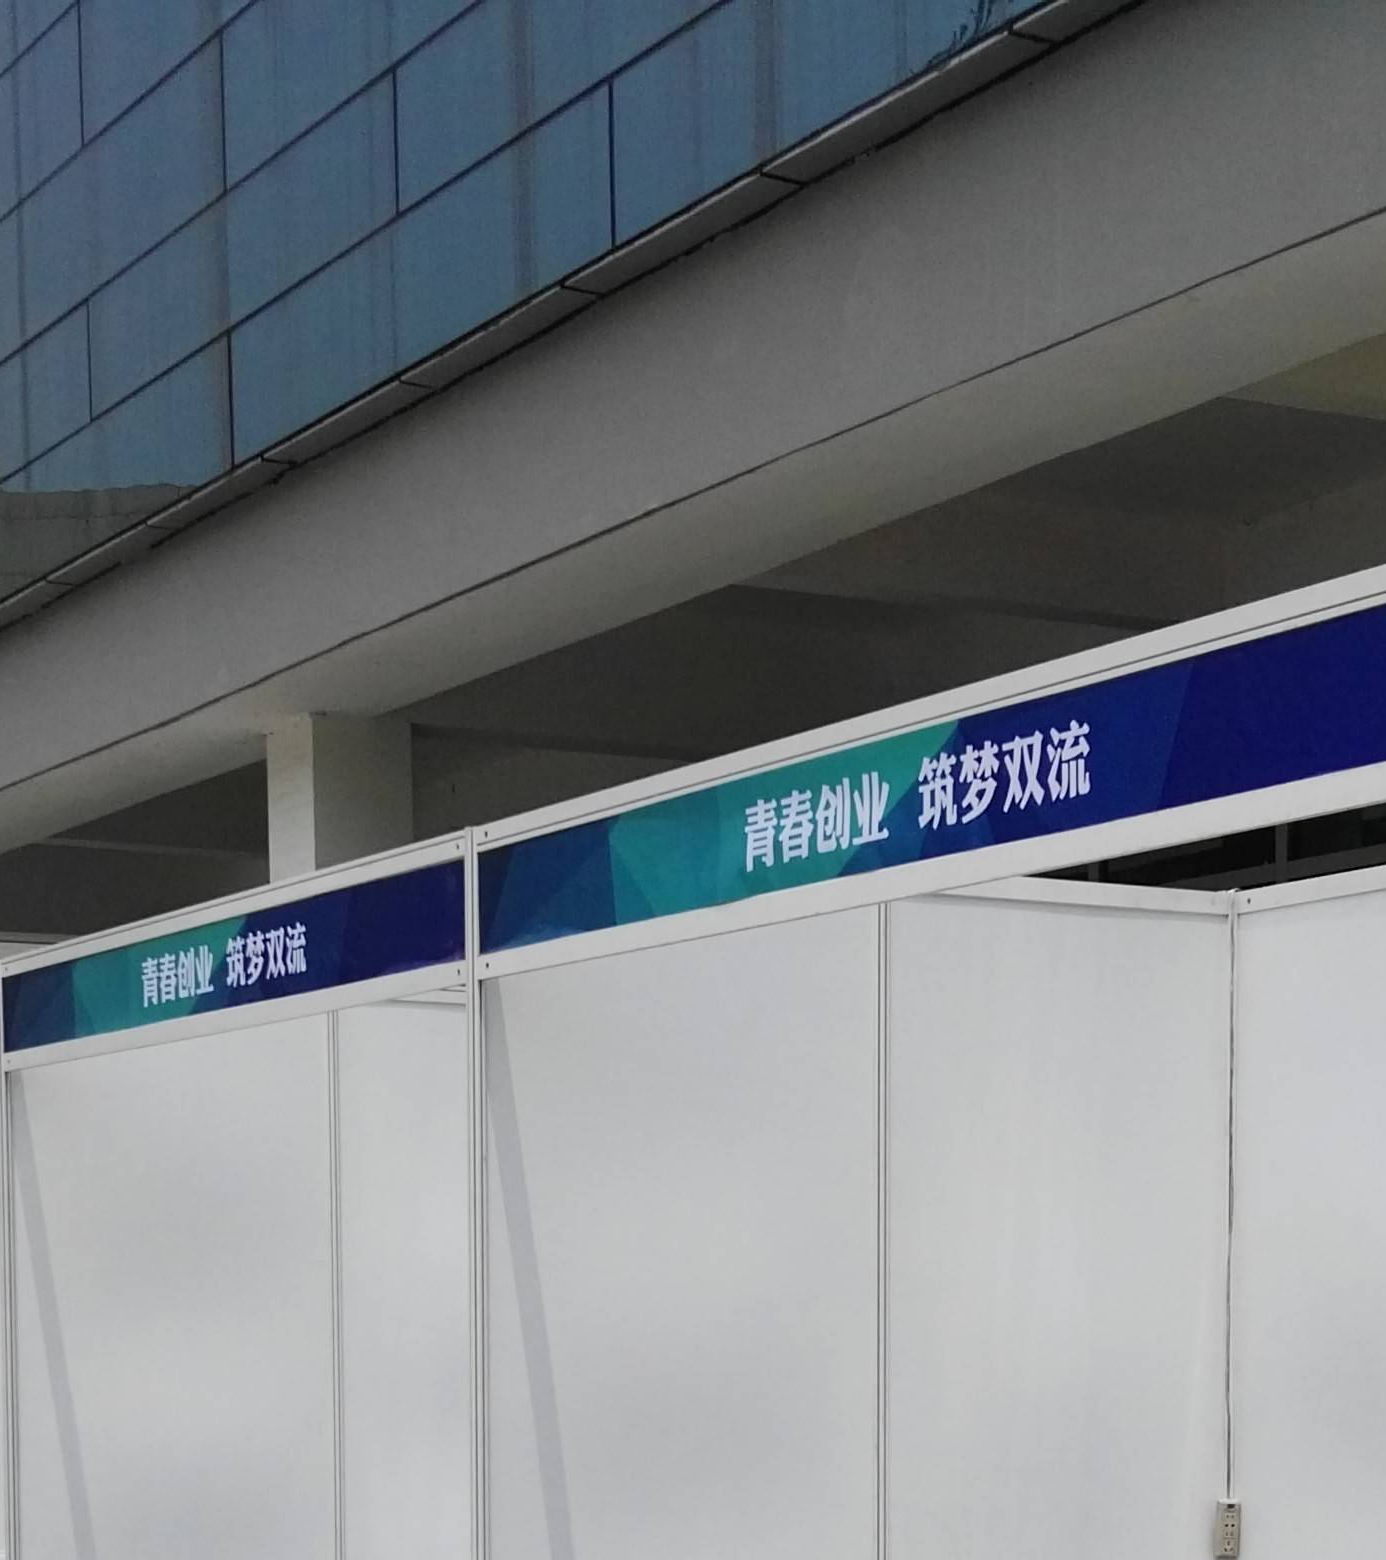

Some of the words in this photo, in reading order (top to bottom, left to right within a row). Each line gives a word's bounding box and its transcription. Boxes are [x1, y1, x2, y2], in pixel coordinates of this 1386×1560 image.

[744, 771, 890, 872] 青春创业
[917, 719, 1091, 831] 筑梦双流
[141, 945, 214, 1008] 青春创业
[226, 922, 307, 988] 筑梦双流
